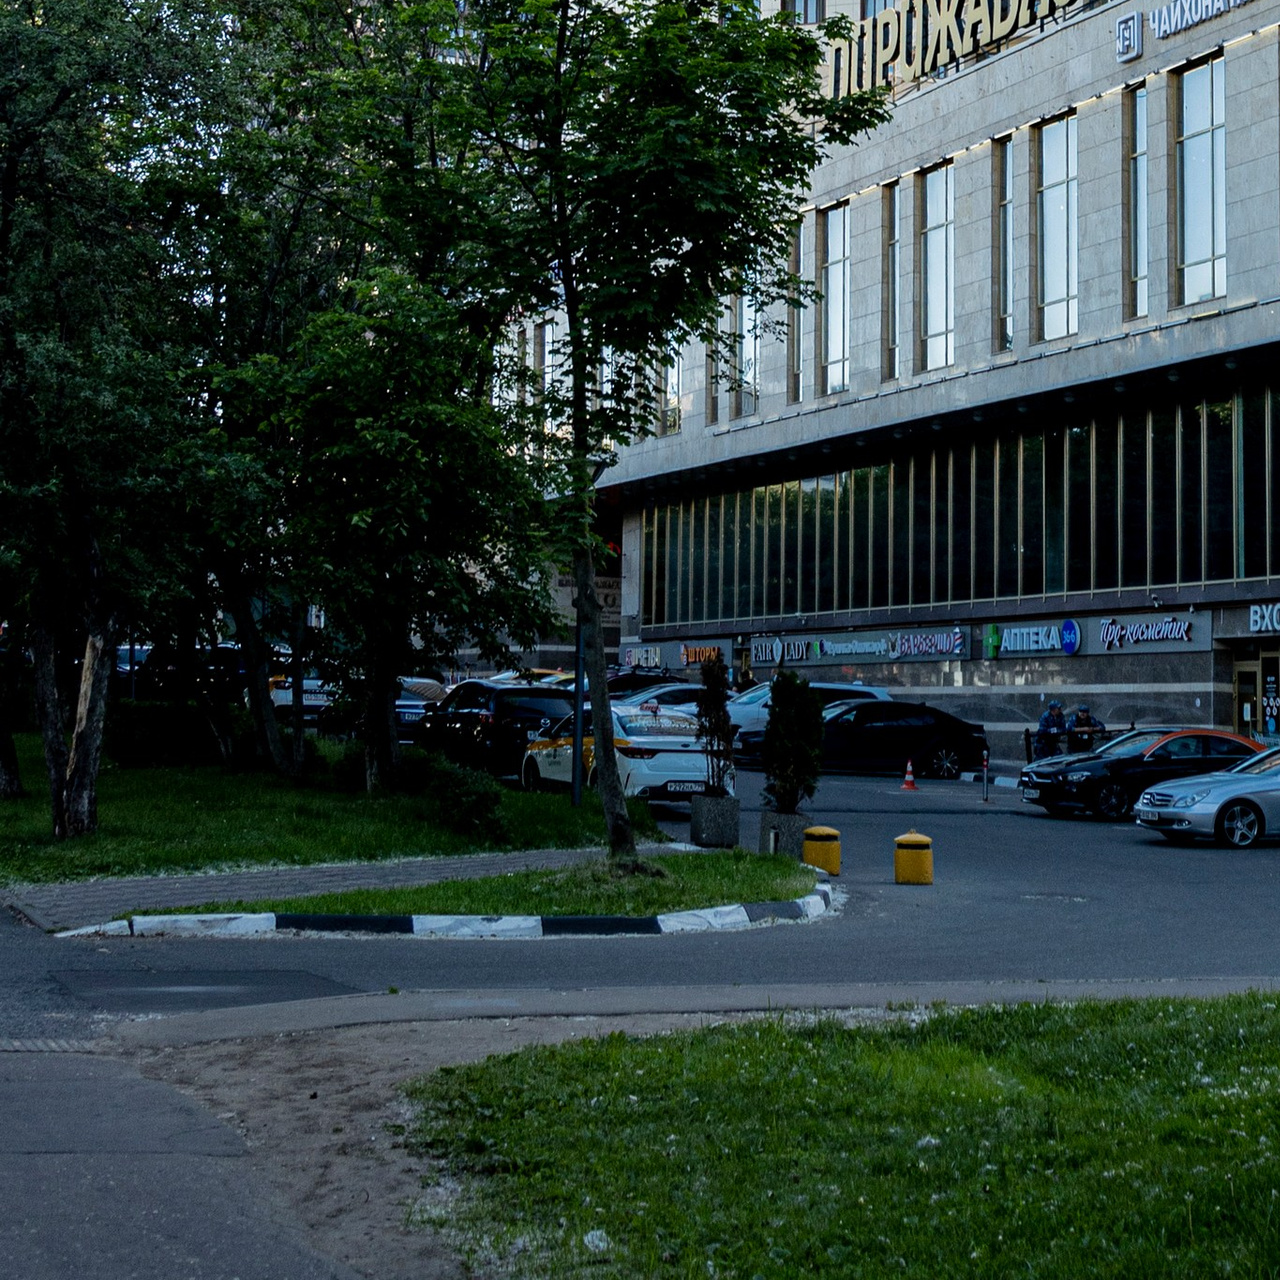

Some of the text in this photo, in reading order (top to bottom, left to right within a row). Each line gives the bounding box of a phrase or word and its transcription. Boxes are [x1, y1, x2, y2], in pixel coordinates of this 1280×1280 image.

[1001, 626, 1062, 651] АПТЕКА
[752, 643, 773, 661] FAIR
[784, 641, 809, 660] LADY
